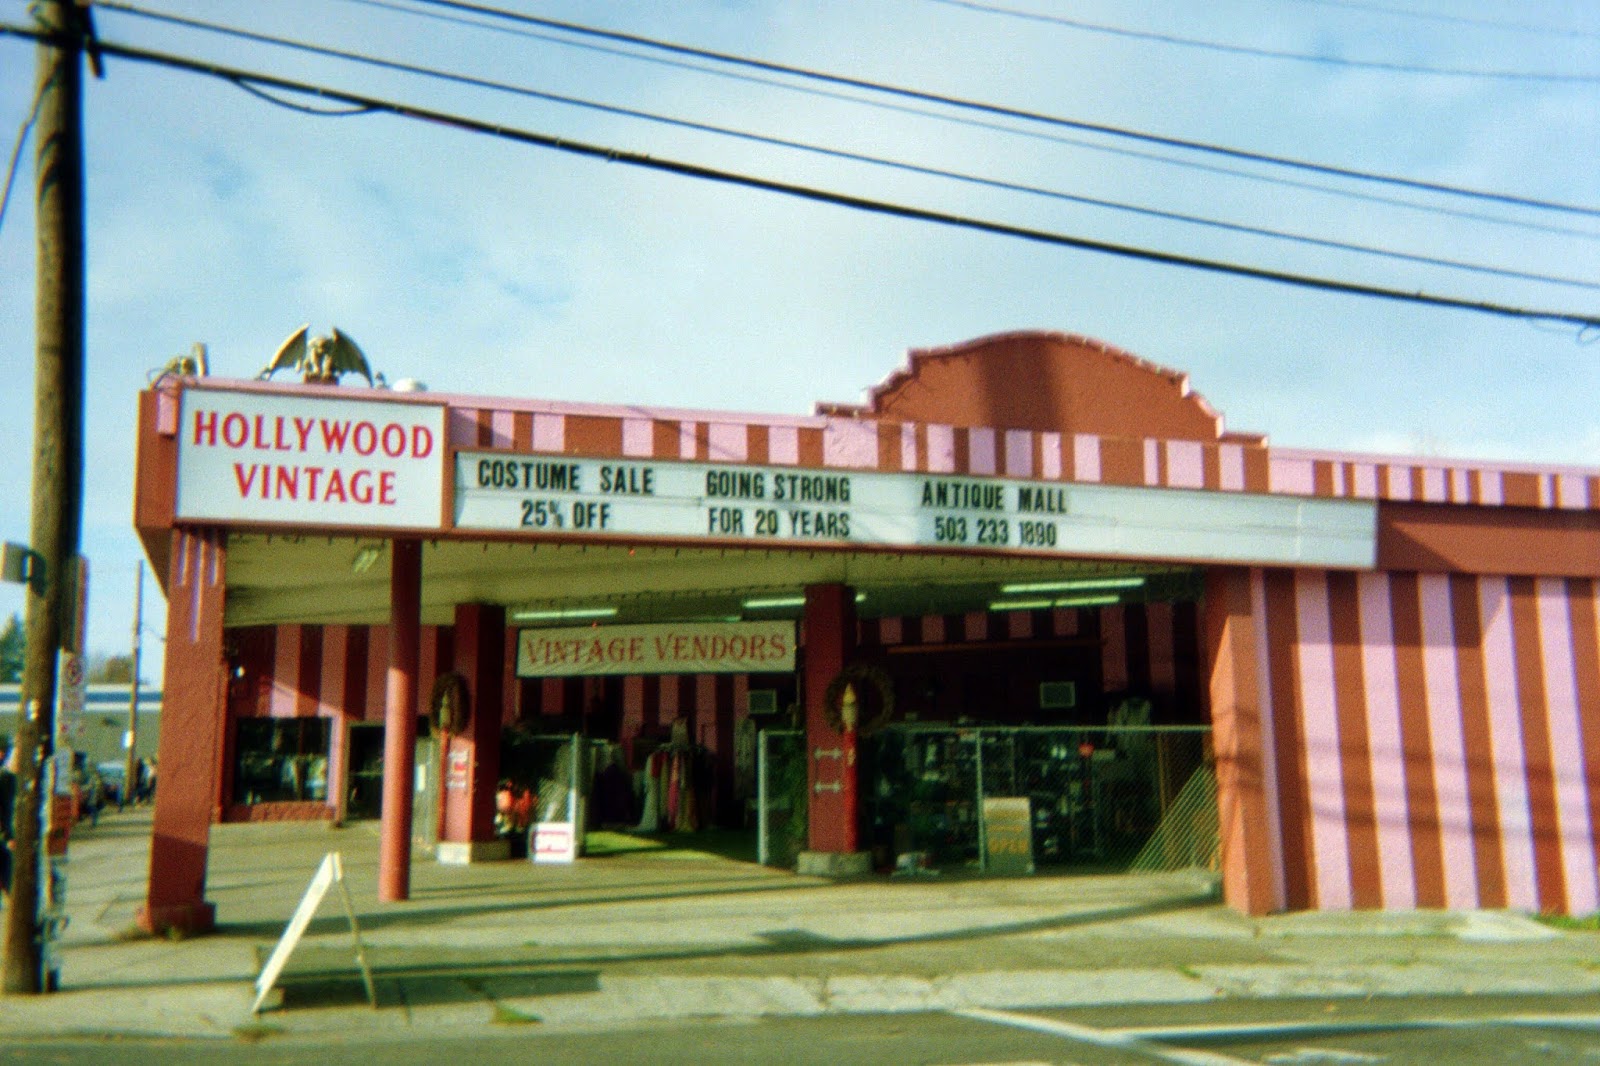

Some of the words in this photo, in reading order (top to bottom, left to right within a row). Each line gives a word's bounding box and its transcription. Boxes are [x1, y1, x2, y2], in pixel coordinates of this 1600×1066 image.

[193, 409, 434, 459] HOLLYWOOD
[234, 462, 397, 505] VINTAGE
[478, 459, 580, 491] COSTUME
[600, 465, 655, 494] SALE
[706, 471, 765, 498] GOING
[773, 474, 851, 503] STRONG
[921, 481, 1006, 512] ANTIQUE
[1018, 487, 1067, 514] MALL
[521, 500, 564, 529] 25%
[573, 503, 611, 530] OFF
[708, 507, 744, 534] FOR
[755, 509, 779, 536] 20
[788, 511, 851, 538] YEARS
[934, 516, 967, 543] 503
[976, 519, 1009, 545] 233
[1019, 521, 1058, 548] 1890
[525, 636, 646, 665] VINTAGE
[654, 633, 788, 662] VENDORS
